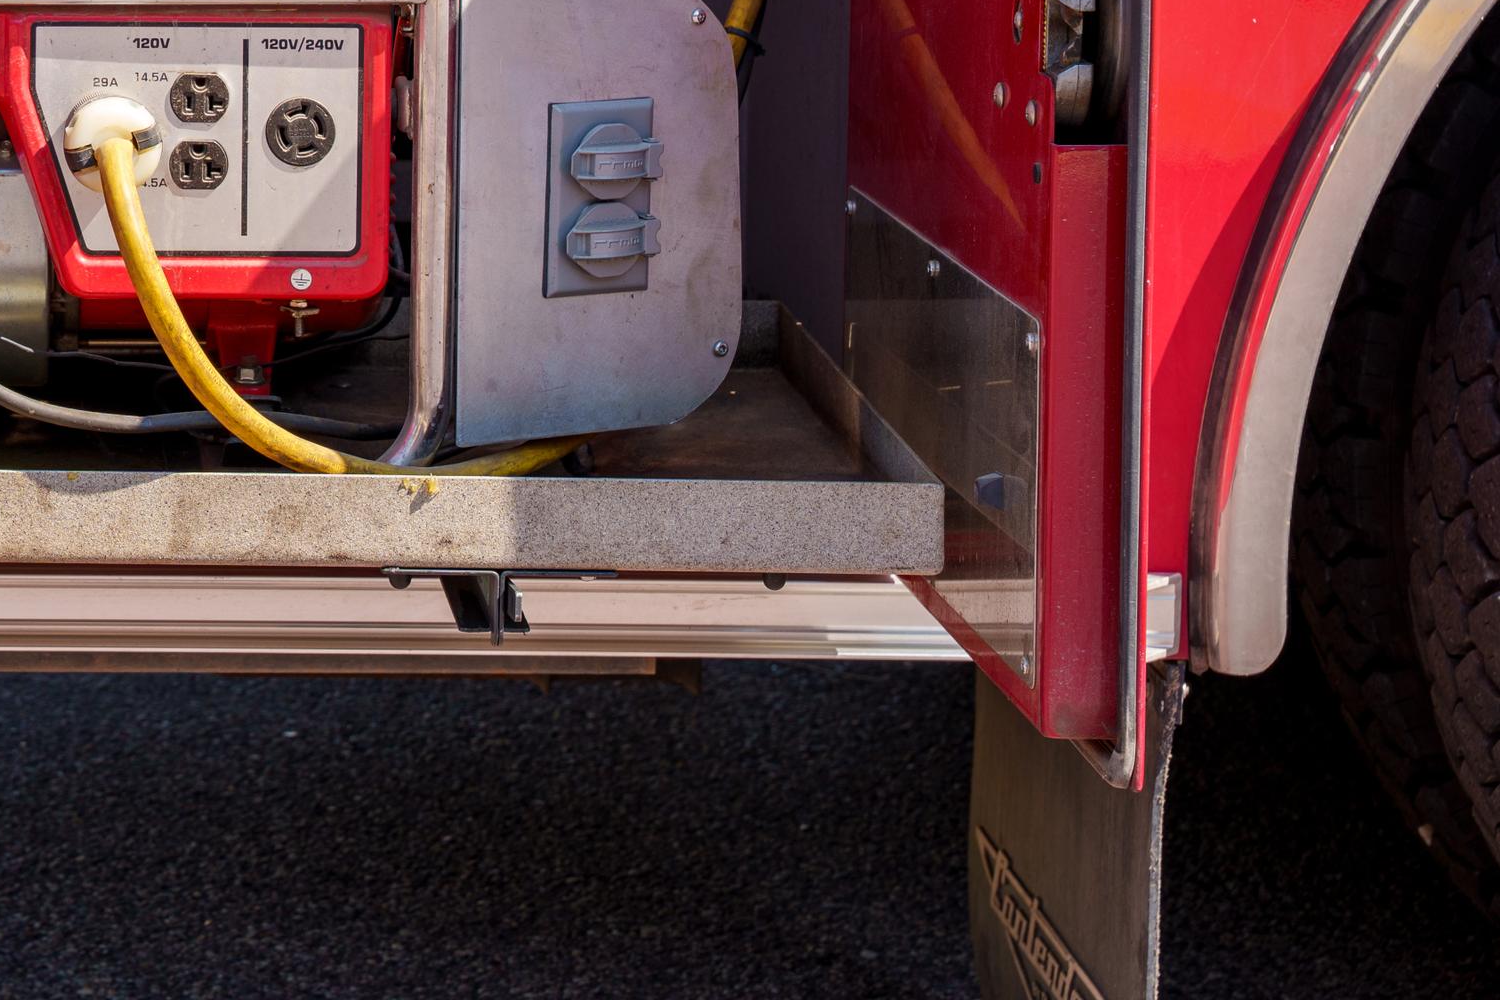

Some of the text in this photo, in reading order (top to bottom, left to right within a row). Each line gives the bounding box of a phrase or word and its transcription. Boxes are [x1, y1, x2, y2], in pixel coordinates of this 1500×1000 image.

[132, 37, 171, 49] 120V
[261, 36, 344, 53] 120V/240V
[92, 77, 119, 87] 29A
[134, 71, 169, 82] 14.5A
